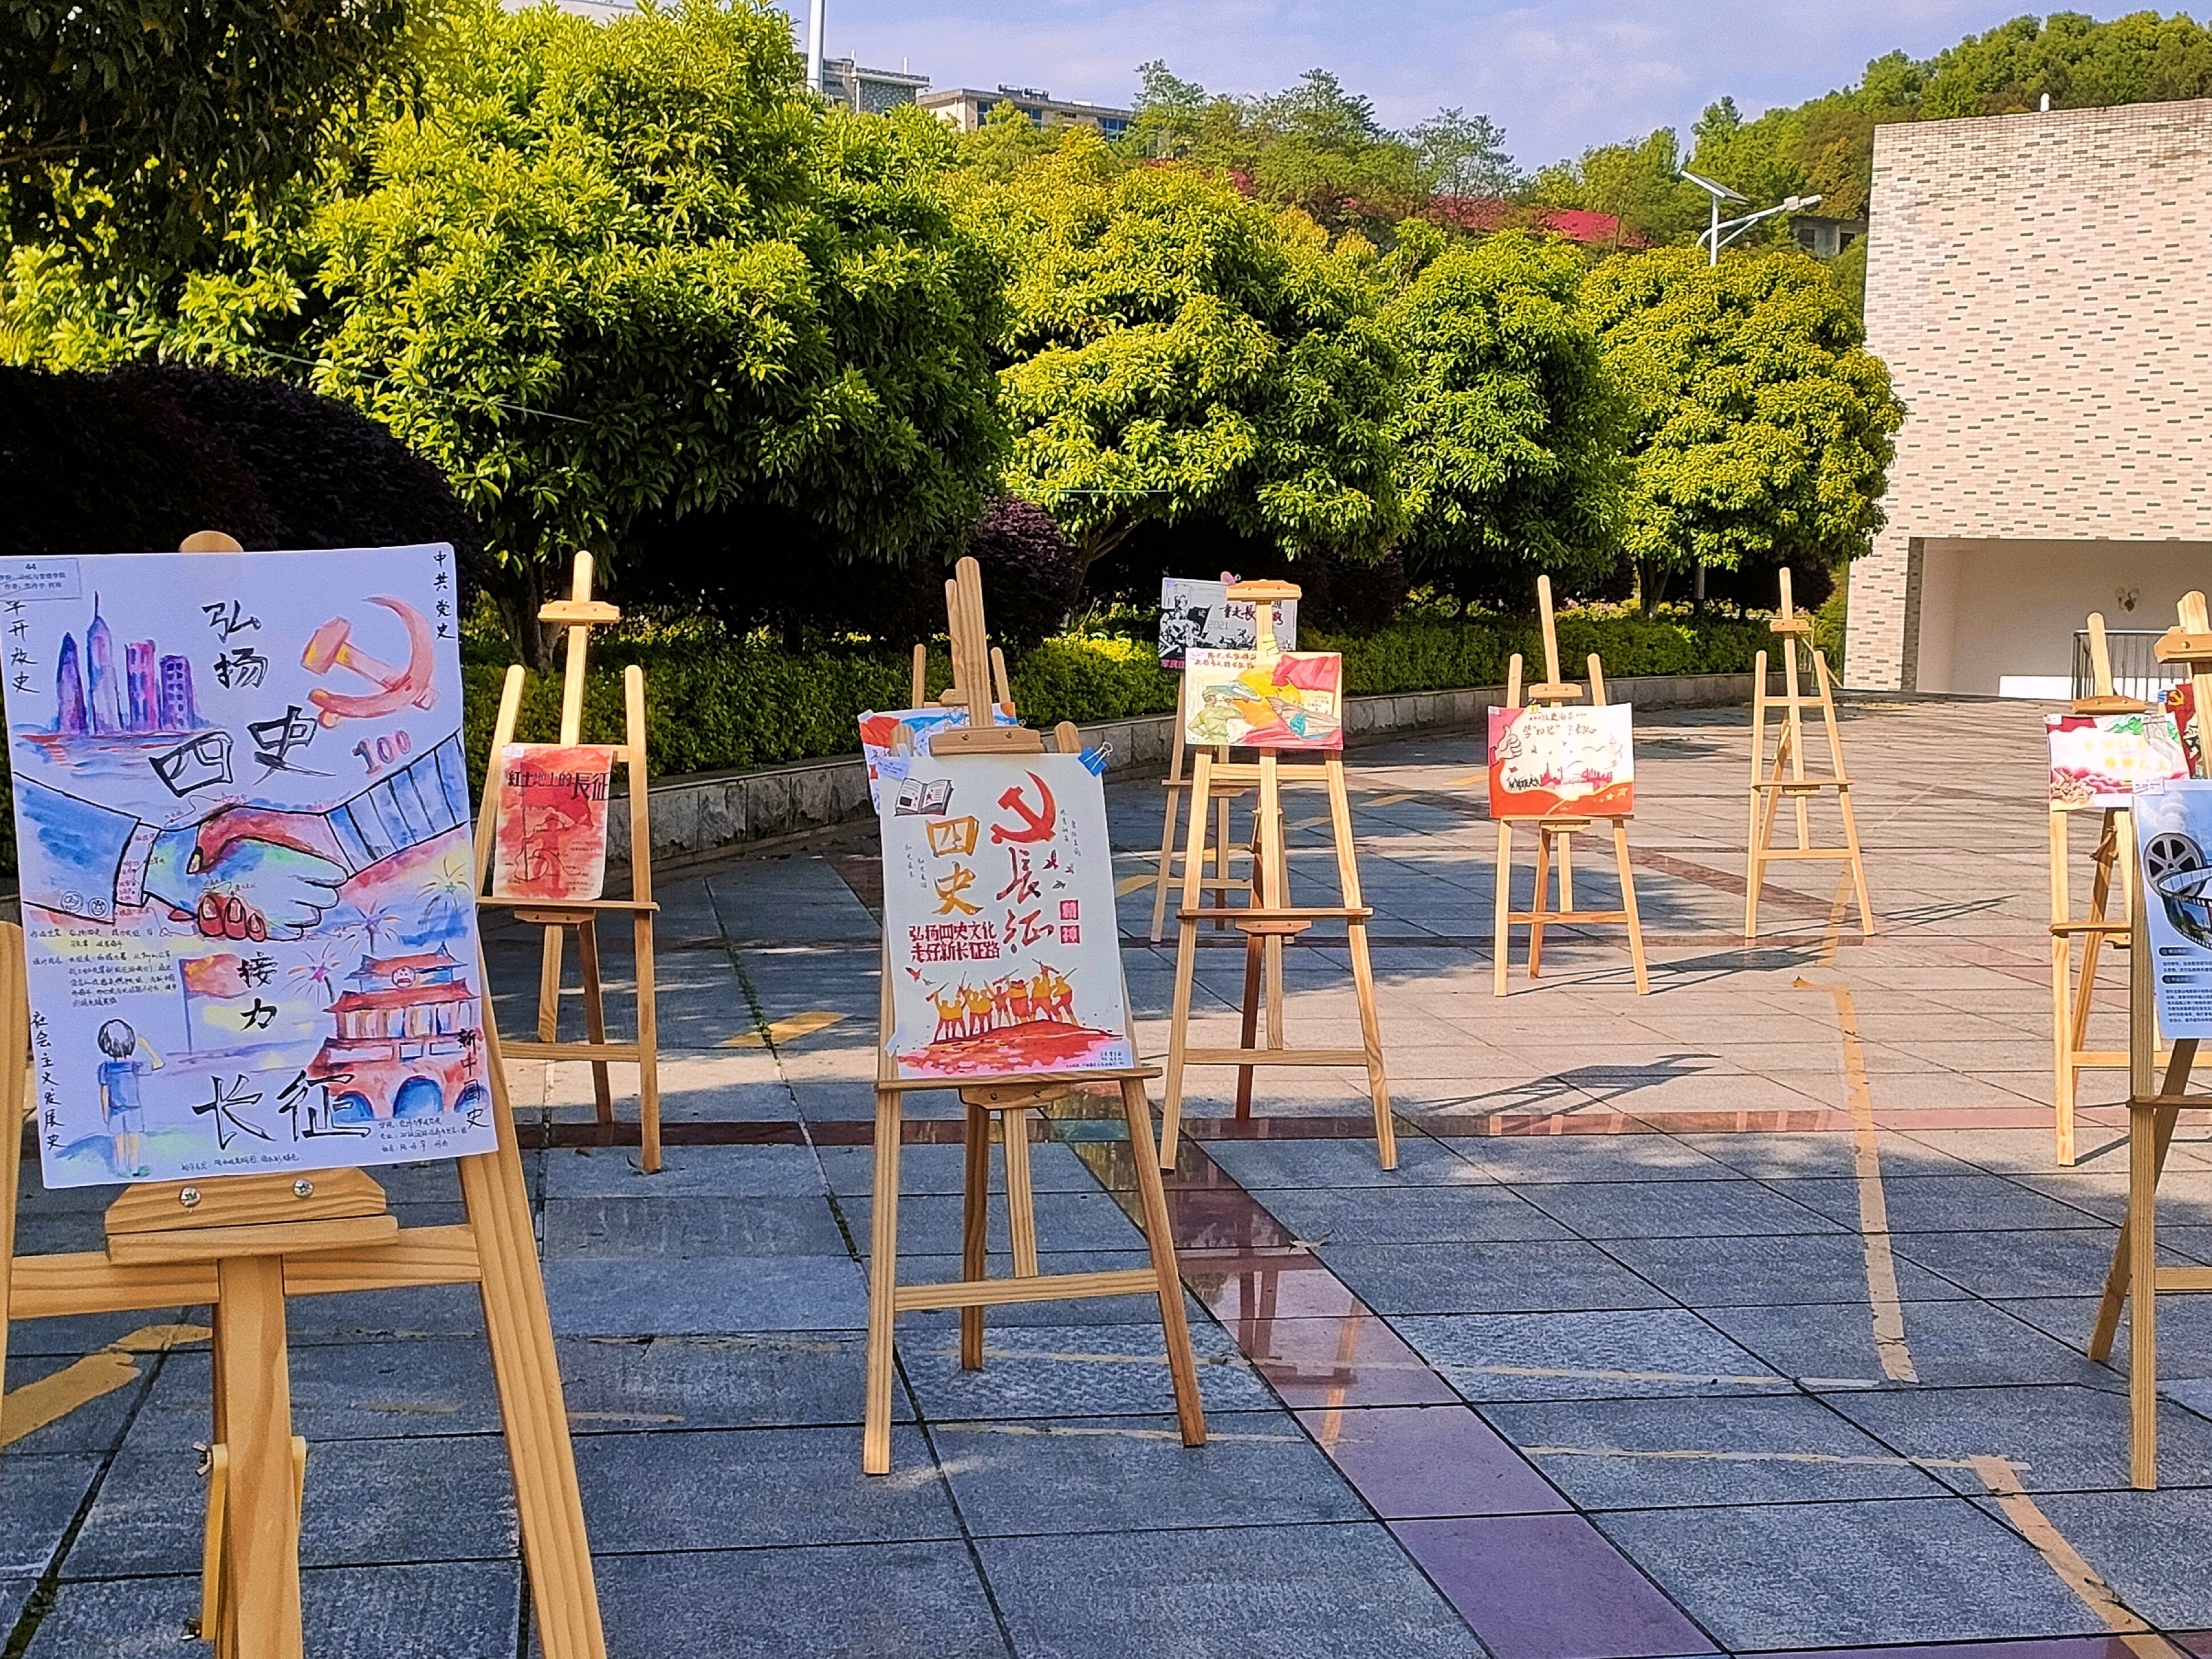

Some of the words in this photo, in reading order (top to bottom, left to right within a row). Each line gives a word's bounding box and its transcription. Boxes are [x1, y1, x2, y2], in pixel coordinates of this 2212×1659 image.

[433, 550, 457, 640] 中共党史
[1207, 620, 1228, 630] 2021
[201, 598, 270, 689] 弘扬
[148, 704, 336, 798] 四史
[352, 730, 411, 776] 100
[924, 815, 984, 916] 四史
[908, 920, 997, 942] 弘扬四史文化
[910, 940, 1000, 963] 走好新长征路
[238, 950, 277, 1032] 接力
[32, 1011, 67, 1150] 社会主义发展史
[192, 1068, 372, 1151] 长征
[456, 1028, 490, 1130] 新中国史
